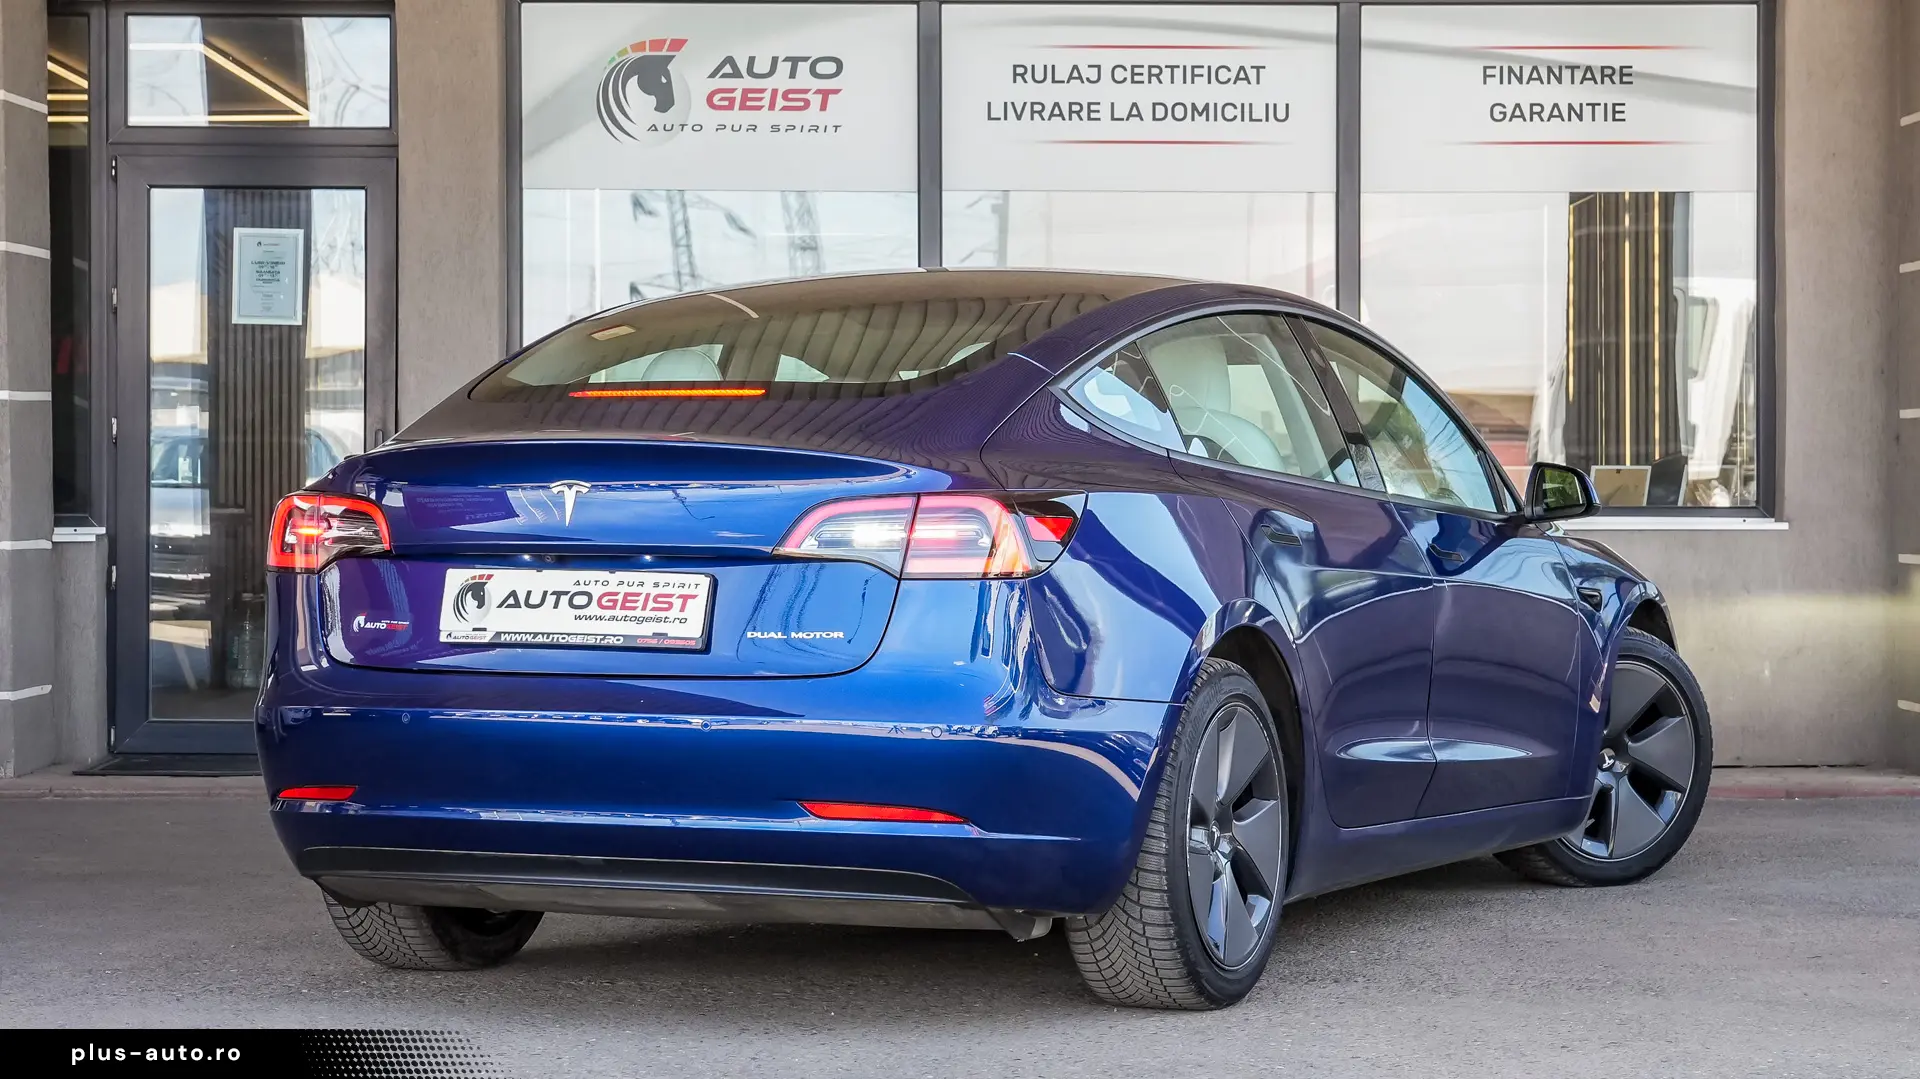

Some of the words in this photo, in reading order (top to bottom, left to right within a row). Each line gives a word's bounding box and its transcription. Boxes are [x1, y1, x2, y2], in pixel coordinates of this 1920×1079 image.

[706, 55, 844, 79] AUTO
[1012, 64, 1102, 84] RULAJ
[1110, 65, 1266, 85] CERTIFICAT
[1482, 65, 1634, 85] FINANTARE
[706, 88, 843, 112] GEIST
[986, 101, 1101, 121] LIVRARE
[1110, 102, 1144, 121] LA
[1151, 102, 1290, 123] DOMICILIU
[1489, 103, 1626, 123] GARANTIE
[646, 123, 703, 132] AUTO
[715, 124, 758, 132] PUR
[770, 124, 842, 133] SPIRIT
[573, 579, 610, 587] AUTO
[616, 580, 645, 588] PUR
[652, 581, 700, 589] SPIRIT
[574, 613, 688, 625] www.autogeist.ro
[500, 633, 624, 644] WWW.AUTOGEIST.RO
[746, 631, 787, 639] DUAL
[791, 631, 844, 639] MOTOR
